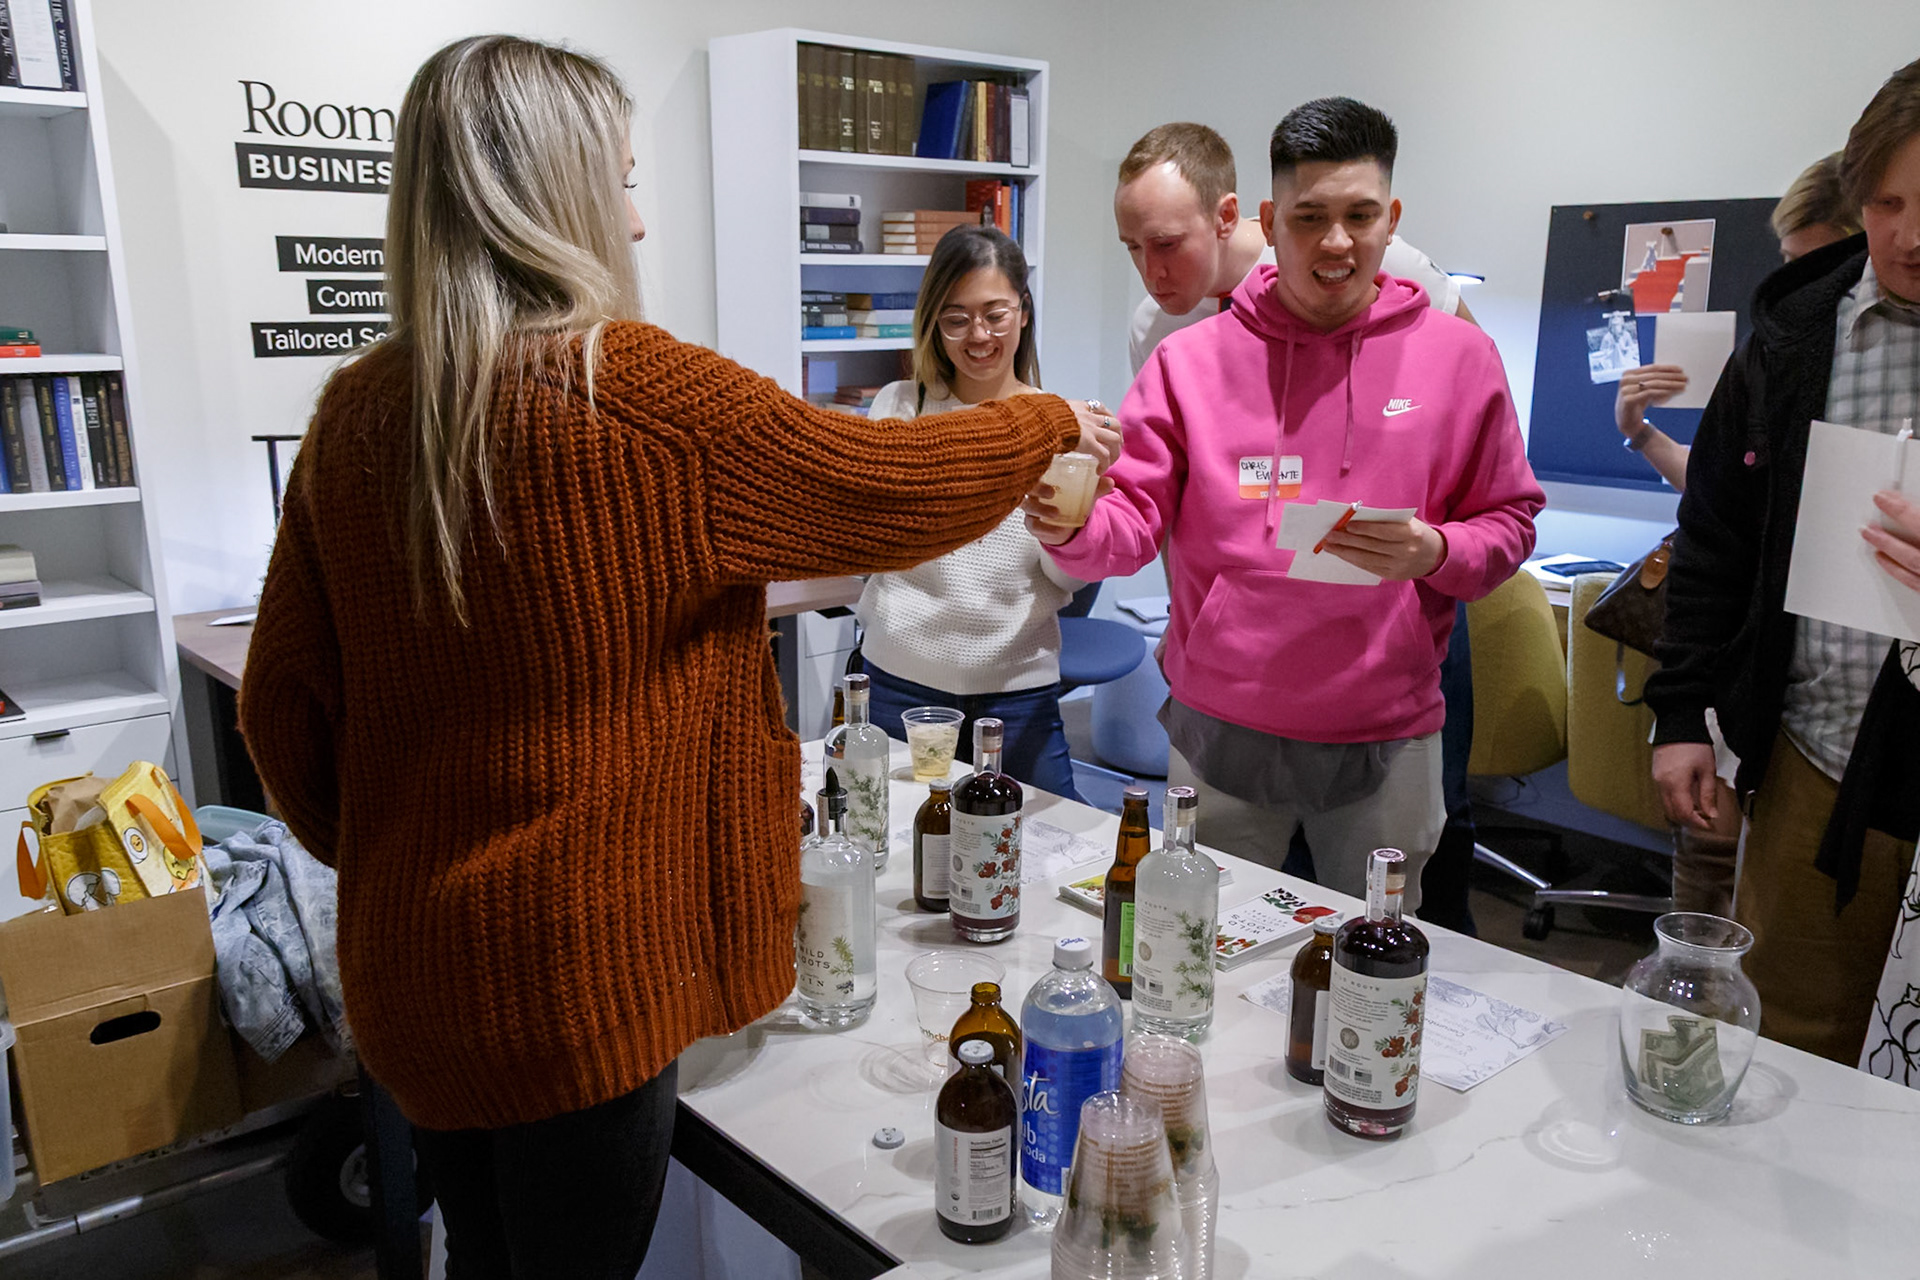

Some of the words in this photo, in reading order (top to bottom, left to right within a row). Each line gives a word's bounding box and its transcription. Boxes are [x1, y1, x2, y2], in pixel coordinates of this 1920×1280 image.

[59, 29, 71, 77] VENDETTA
[238, 80, 395, 142] Room
[294, 242, 385, 266] Modern
[259, 327, 354, 351] Tailored
[1387, 398, 1413, 411] NIKE
[799, 955, 830, 970] OOTS
